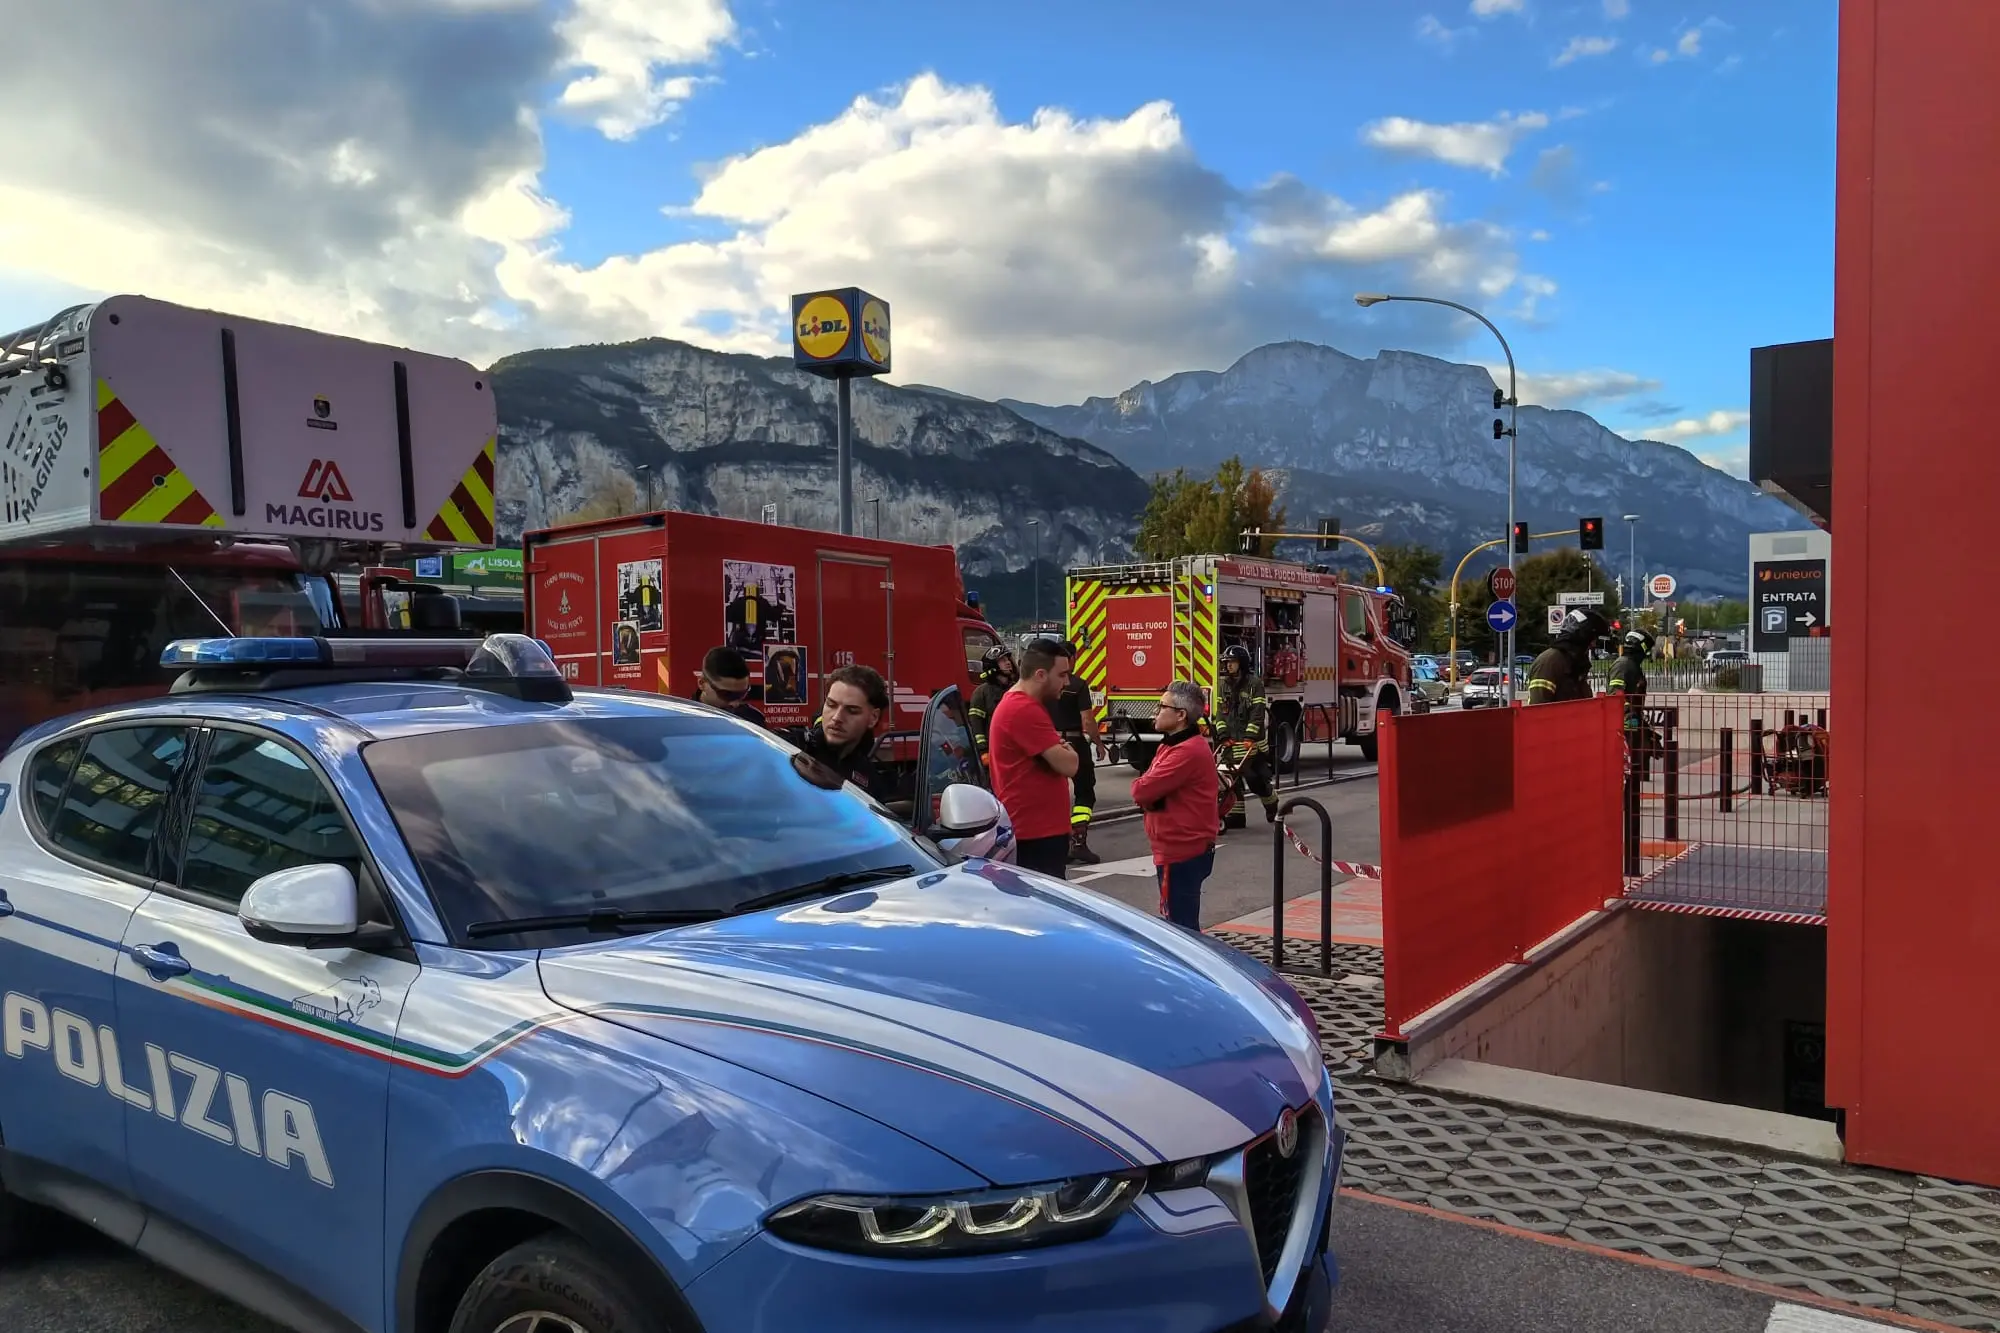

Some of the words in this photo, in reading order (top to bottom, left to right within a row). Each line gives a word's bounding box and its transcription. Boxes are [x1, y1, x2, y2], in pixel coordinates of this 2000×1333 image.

[22, 416, 69, 524] MAGIRUS
[266, 503, 384, 532] MAGIRUS
[488, 557, 522, 568] L'ISOLA
[1238, 563, 1259, 577] VIGILI
[1260, 567, 1273, 578] DEL
[1274, 568, 1296, 580] FUOCO
[1296, 570, 1320, 584] TRENTO
[1774, 570, 1821, 580] unieuro
[1494, 578, 1514, 589] STOP
[1762, 592, 1817, 603] ENTRATA
[1111, 622, 1131, 631] VIGILI
[1131, 622, 1145, 631] DEL
[1145, 621, 1168, 630] FUOCO
[1767, 613, 1783, 631] P
[1126, 632, 1153, 640] TRENTO
[835, 651, 854, 665] 115
[561, 663, 580, 680] 115
[315, 1006, 338, 1023] VOLANTE
[4, 991, 335, 1189] POLIZIA
[537, 1275, 614, 1330] EcoConta
